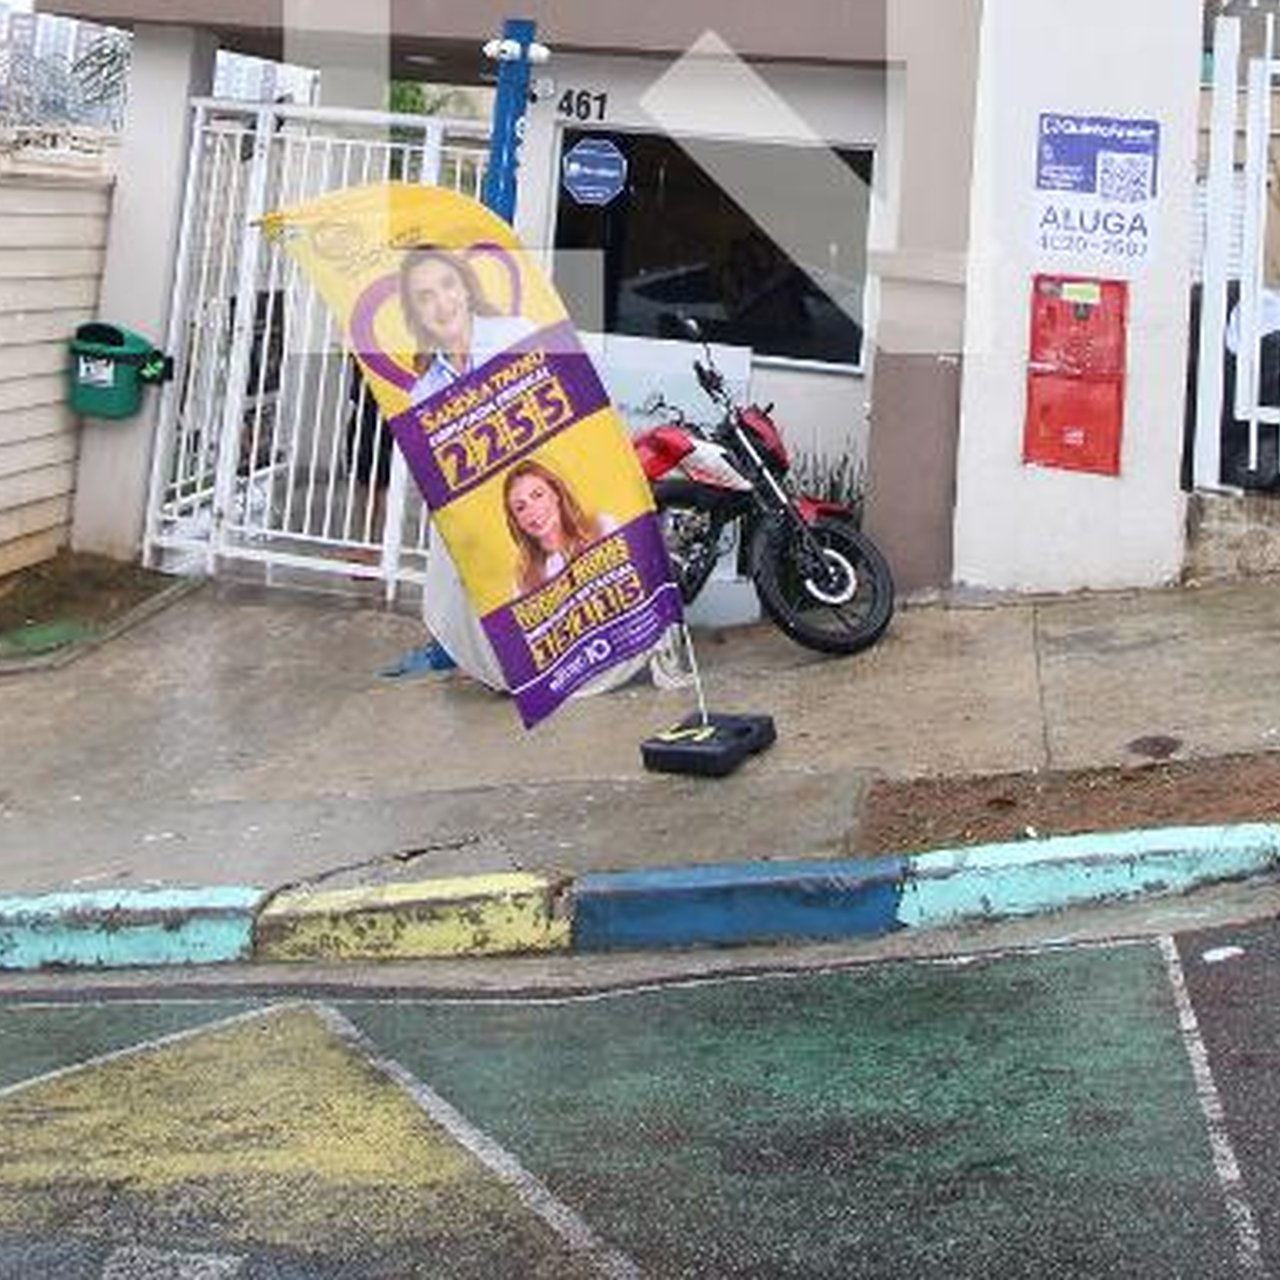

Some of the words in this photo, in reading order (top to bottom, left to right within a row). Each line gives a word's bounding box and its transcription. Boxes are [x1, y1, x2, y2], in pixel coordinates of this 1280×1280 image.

[558, 89, 607, 120] 461
[1039, 204, 1148, 237] ALUGA
[441, 382, 568, 484] 2255
